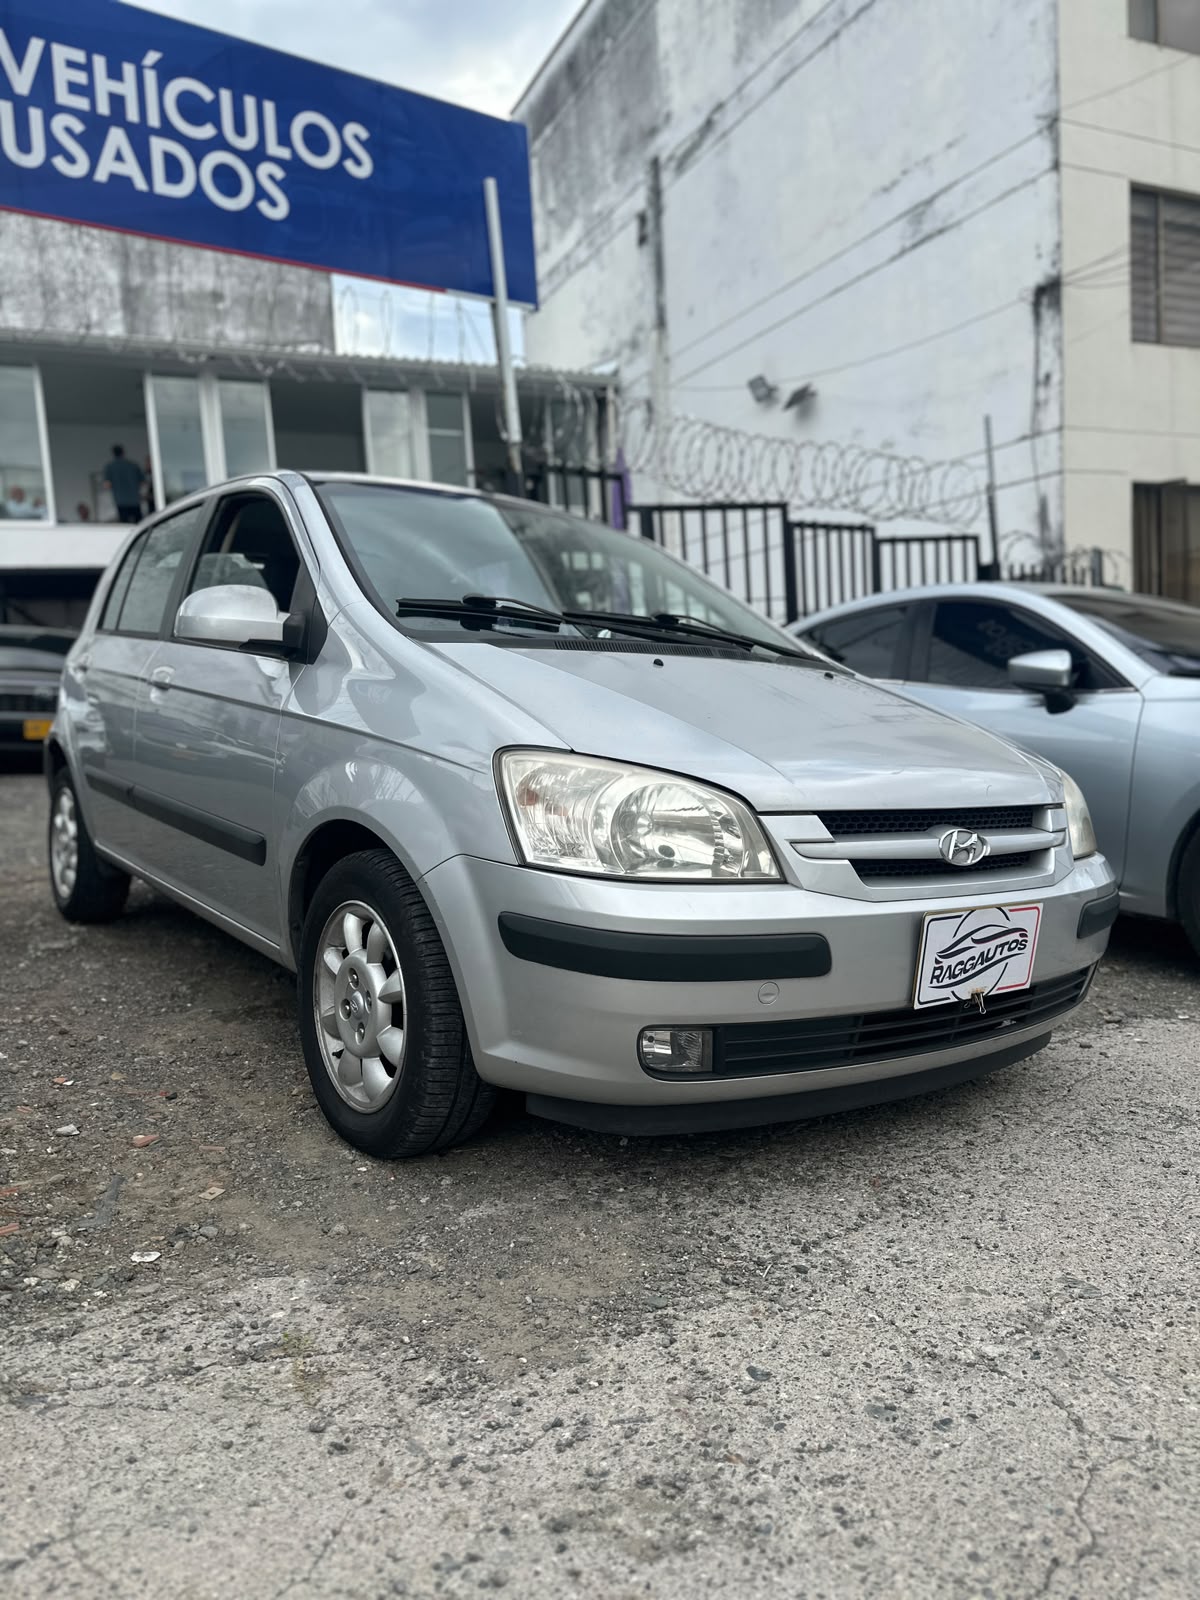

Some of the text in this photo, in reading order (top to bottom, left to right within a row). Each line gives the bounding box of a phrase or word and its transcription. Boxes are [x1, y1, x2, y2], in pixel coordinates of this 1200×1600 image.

[0, 29, 373, 179] VEHÍCULOS
[0, 100, 290, 221] USADOS
[930, 939, 1028, 984] RAGGAUTOS
